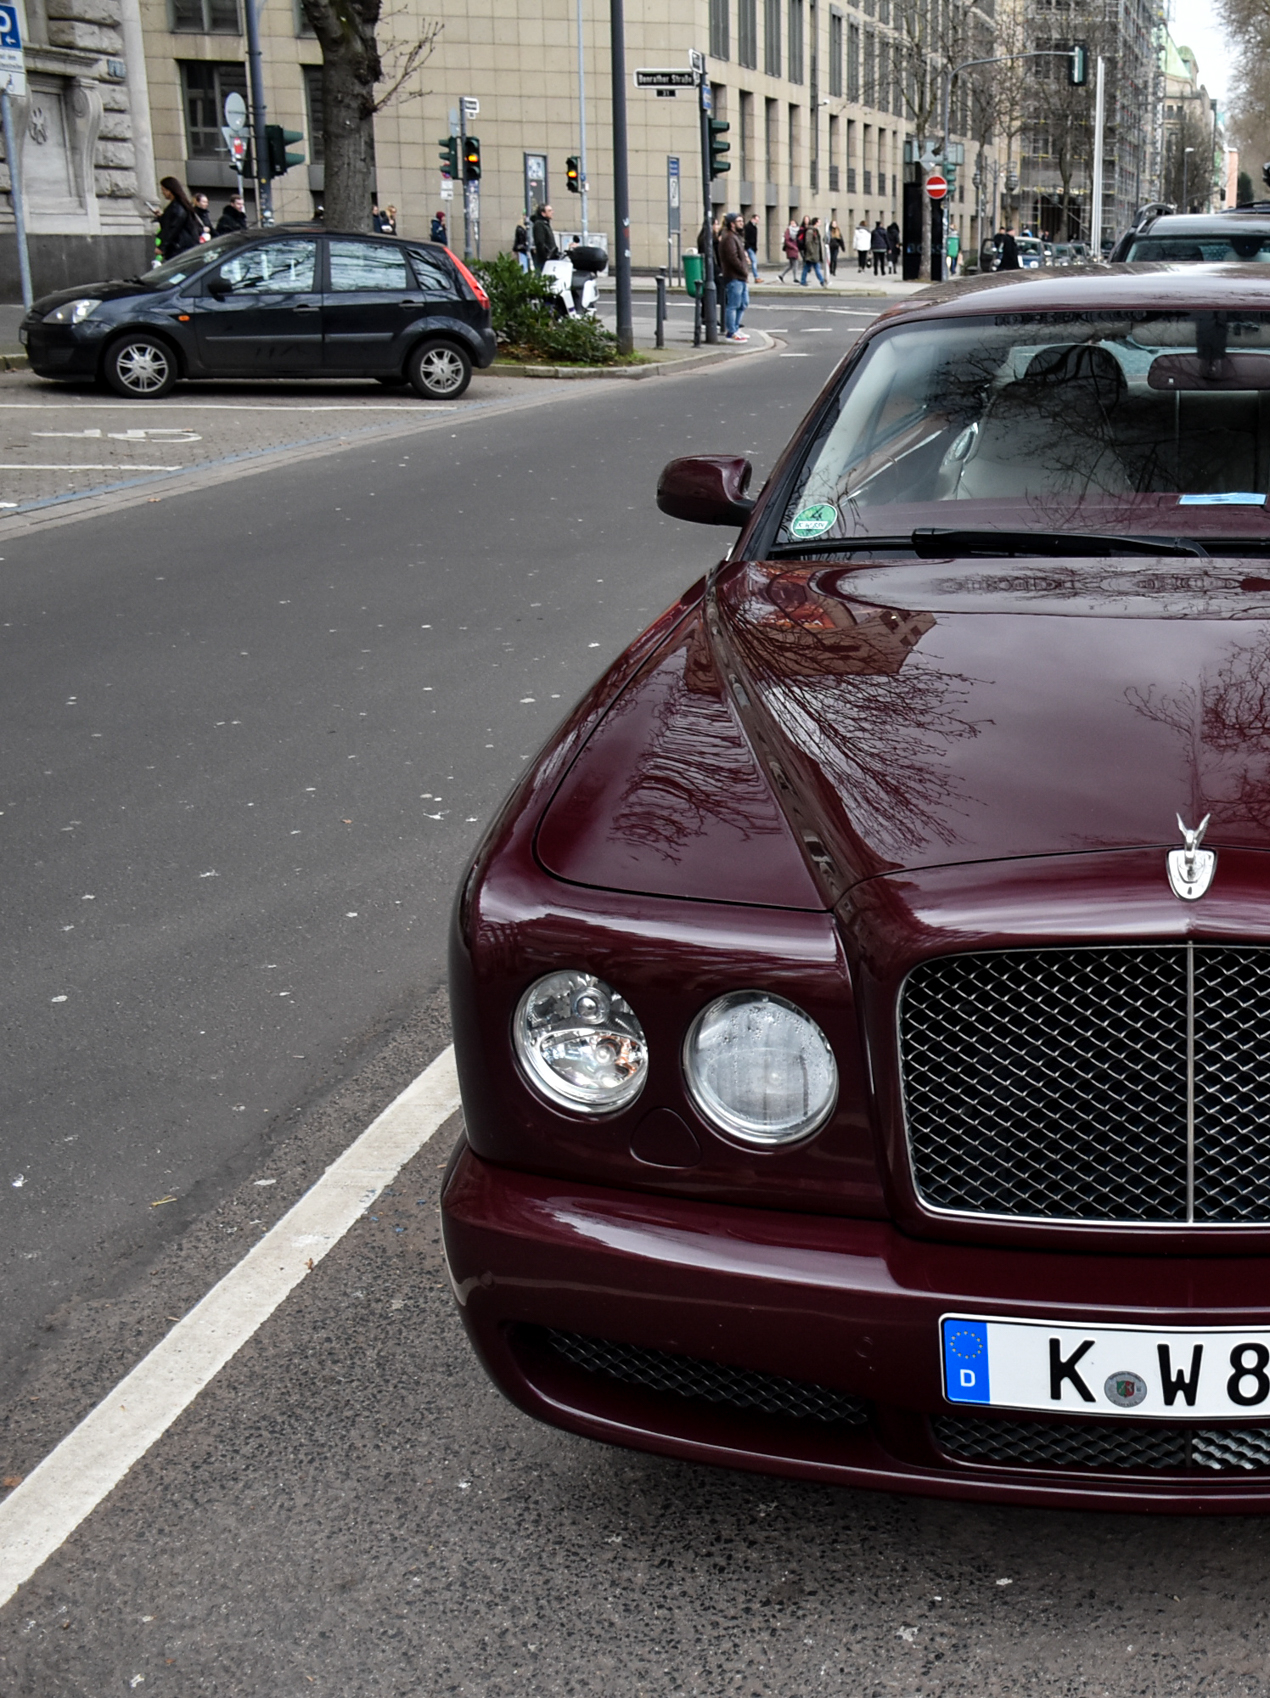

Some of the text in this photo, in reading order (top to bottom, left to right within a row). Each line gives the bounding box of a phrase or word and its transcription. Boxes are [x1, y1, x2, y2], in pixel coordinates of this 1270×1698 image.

[960, 1369, 976, 1388] D
[1049, 1337, 1096, 1403] K
[1157, 1343, 1204, 1406] W
